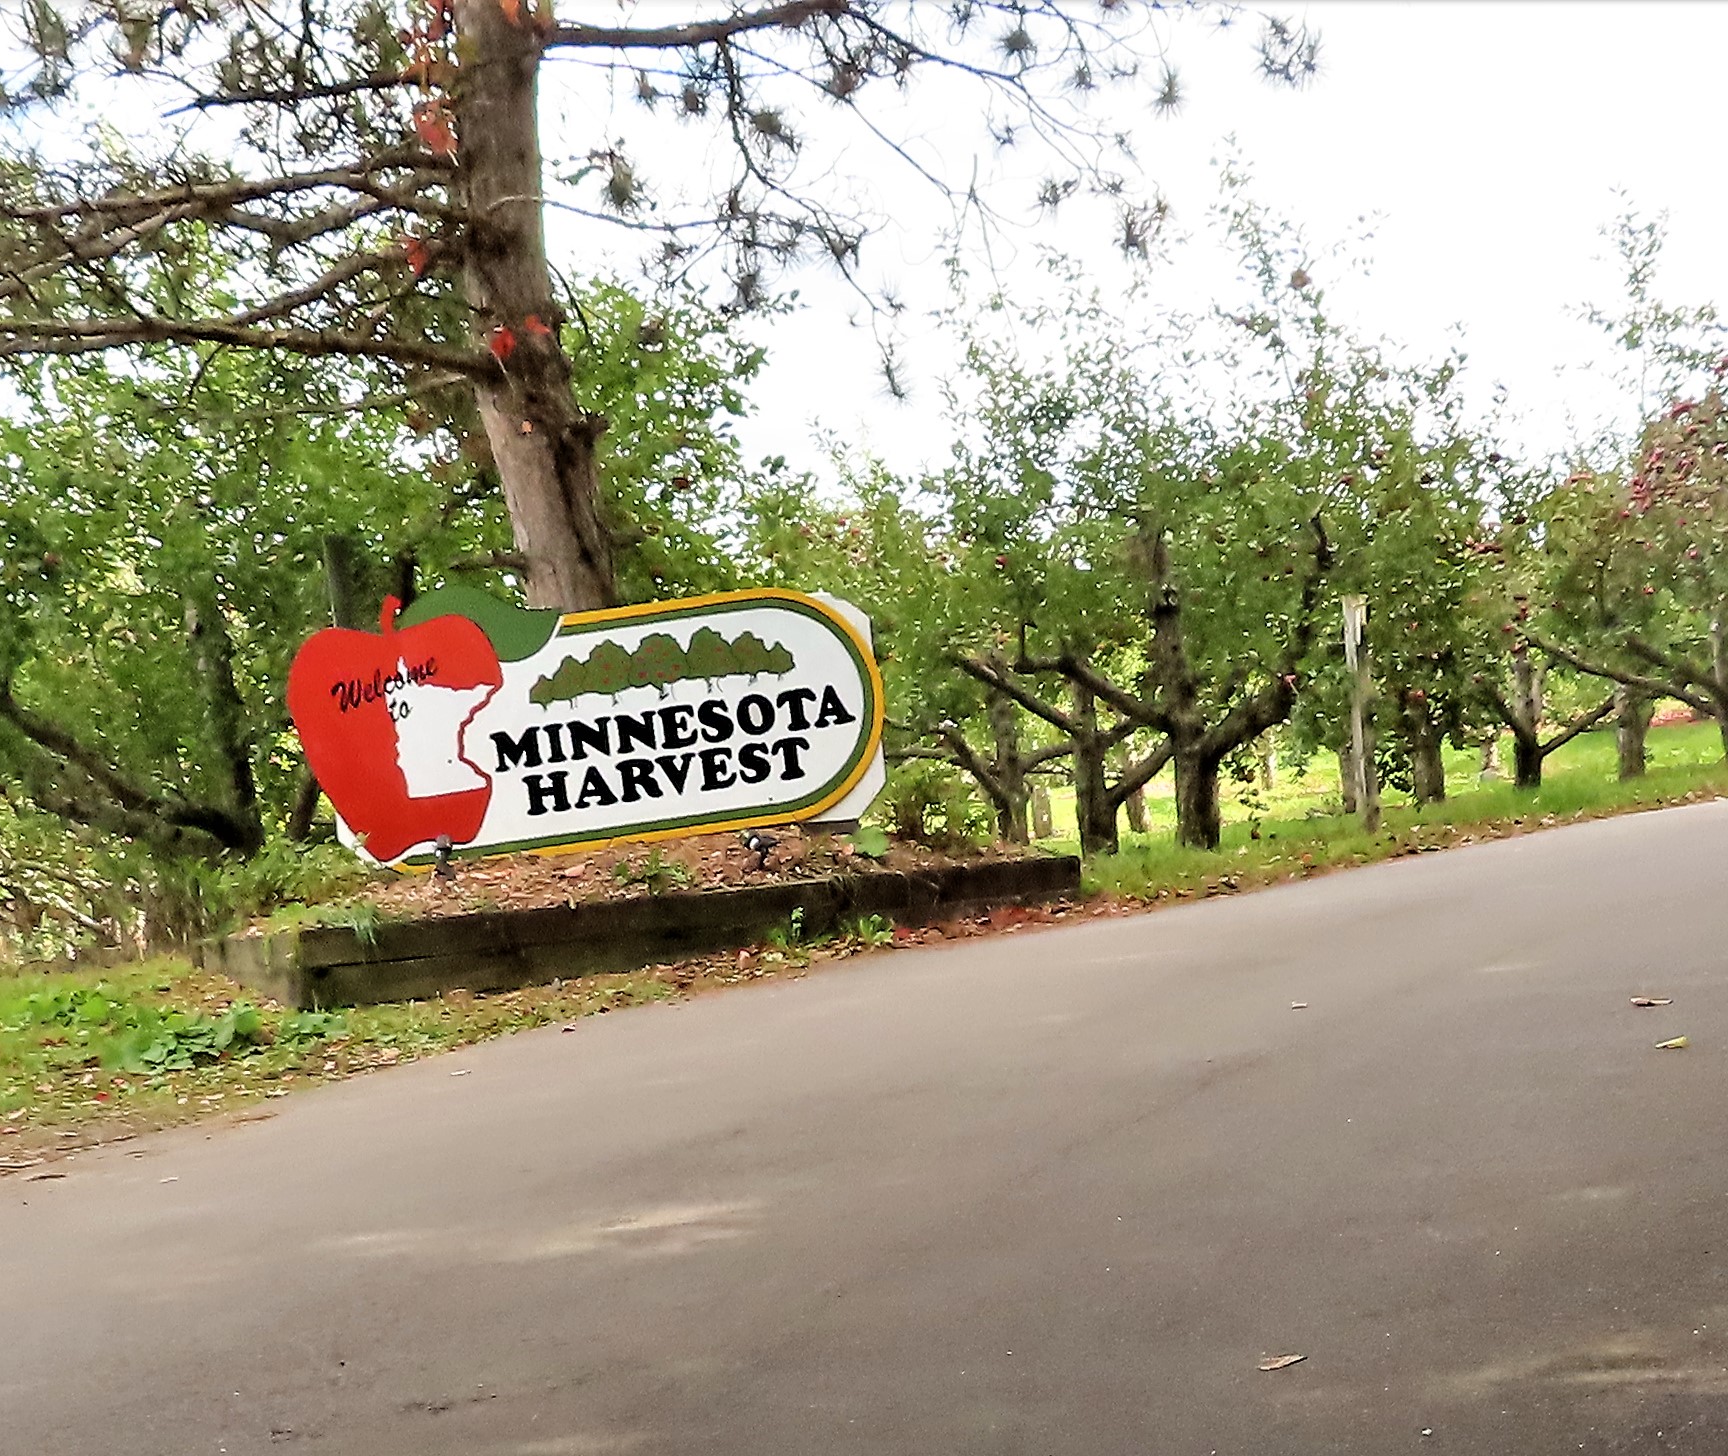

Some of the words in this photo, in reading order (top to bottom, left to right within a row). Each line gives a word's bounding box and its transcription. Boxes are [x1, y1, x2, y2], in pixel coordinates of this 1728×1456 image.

[331, 657, 438, 713] Welcome
[389, 698, 412, 722] to
[489, 685, 856, 773] MINNESOTA
[522, 736, 810, 816] HARVEST
